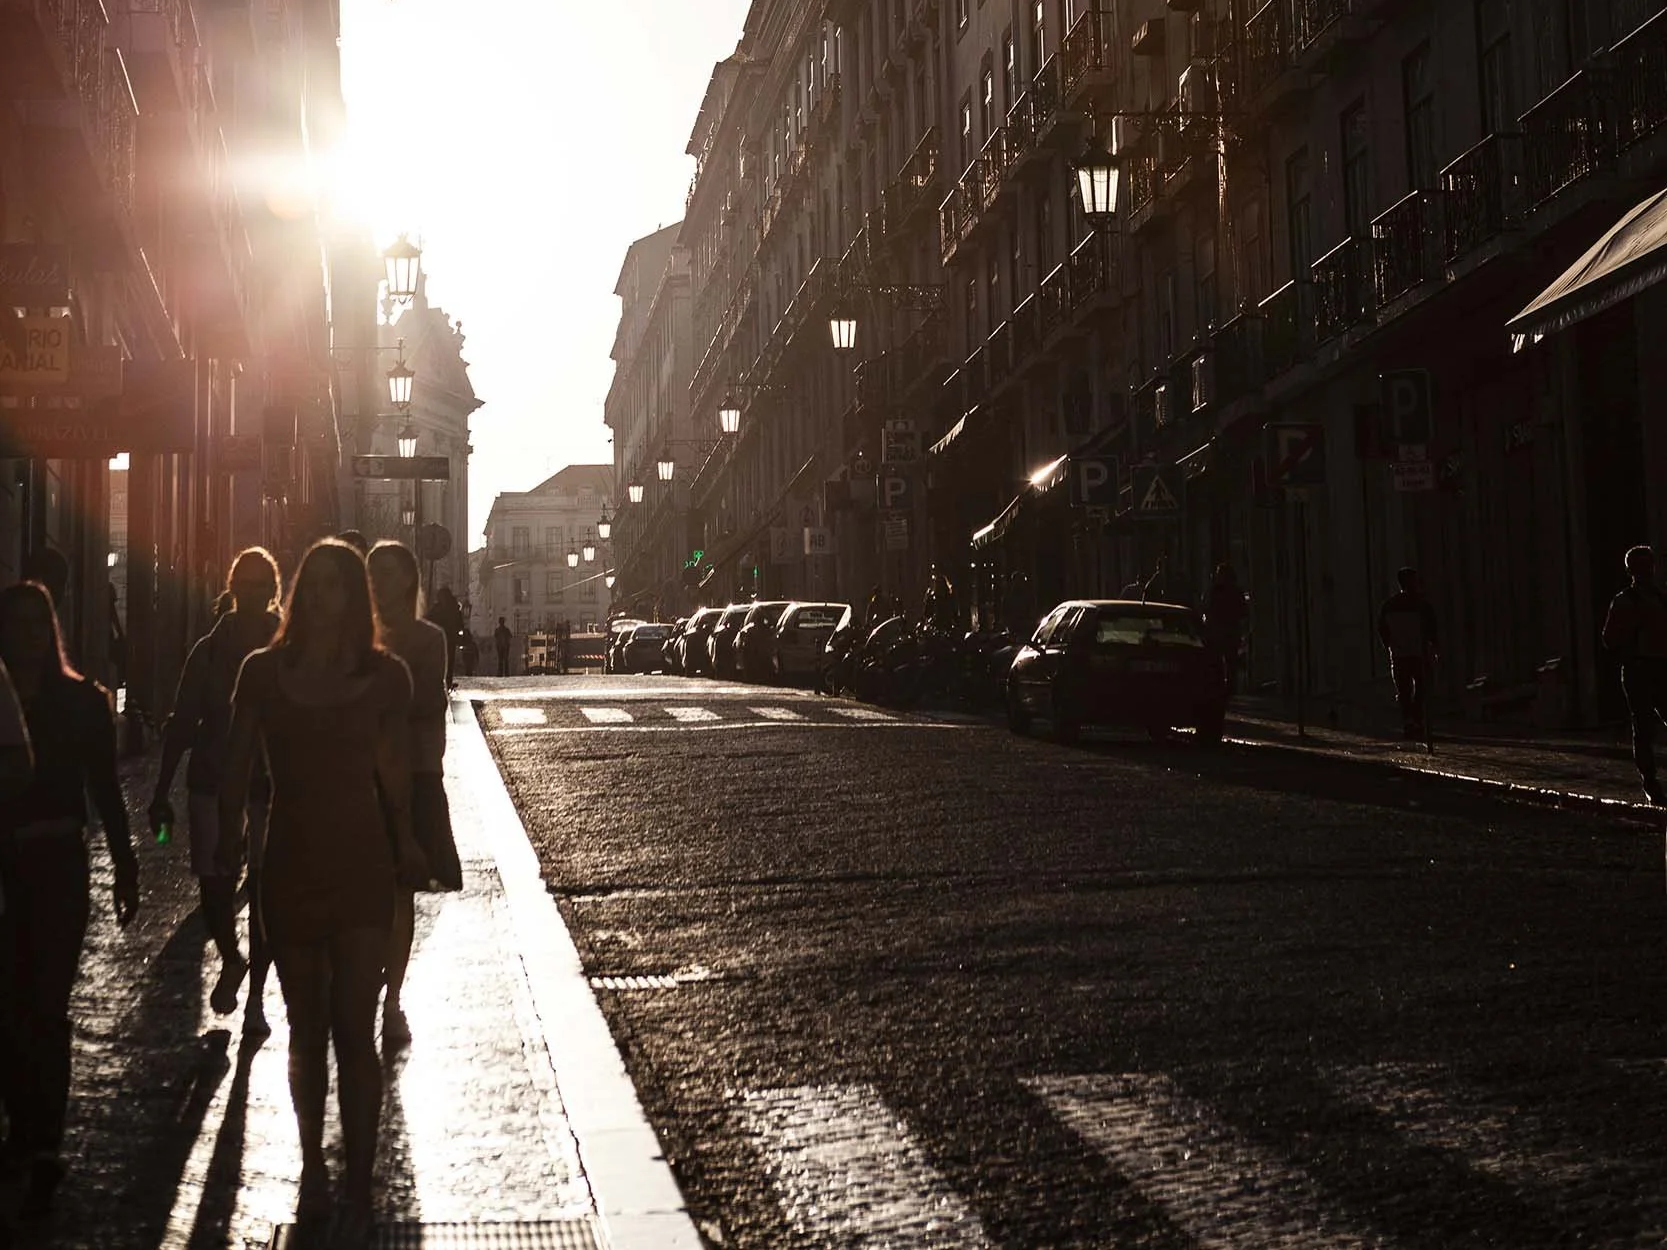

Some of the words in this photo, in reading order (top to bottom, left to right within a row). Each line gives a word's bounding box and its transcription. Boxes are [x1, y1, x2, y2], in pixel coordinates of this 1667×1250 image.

[1391, 378, 1418, 438] P
[884, 477, 907, 507] P
[1079, 461, 1108, 502] P
